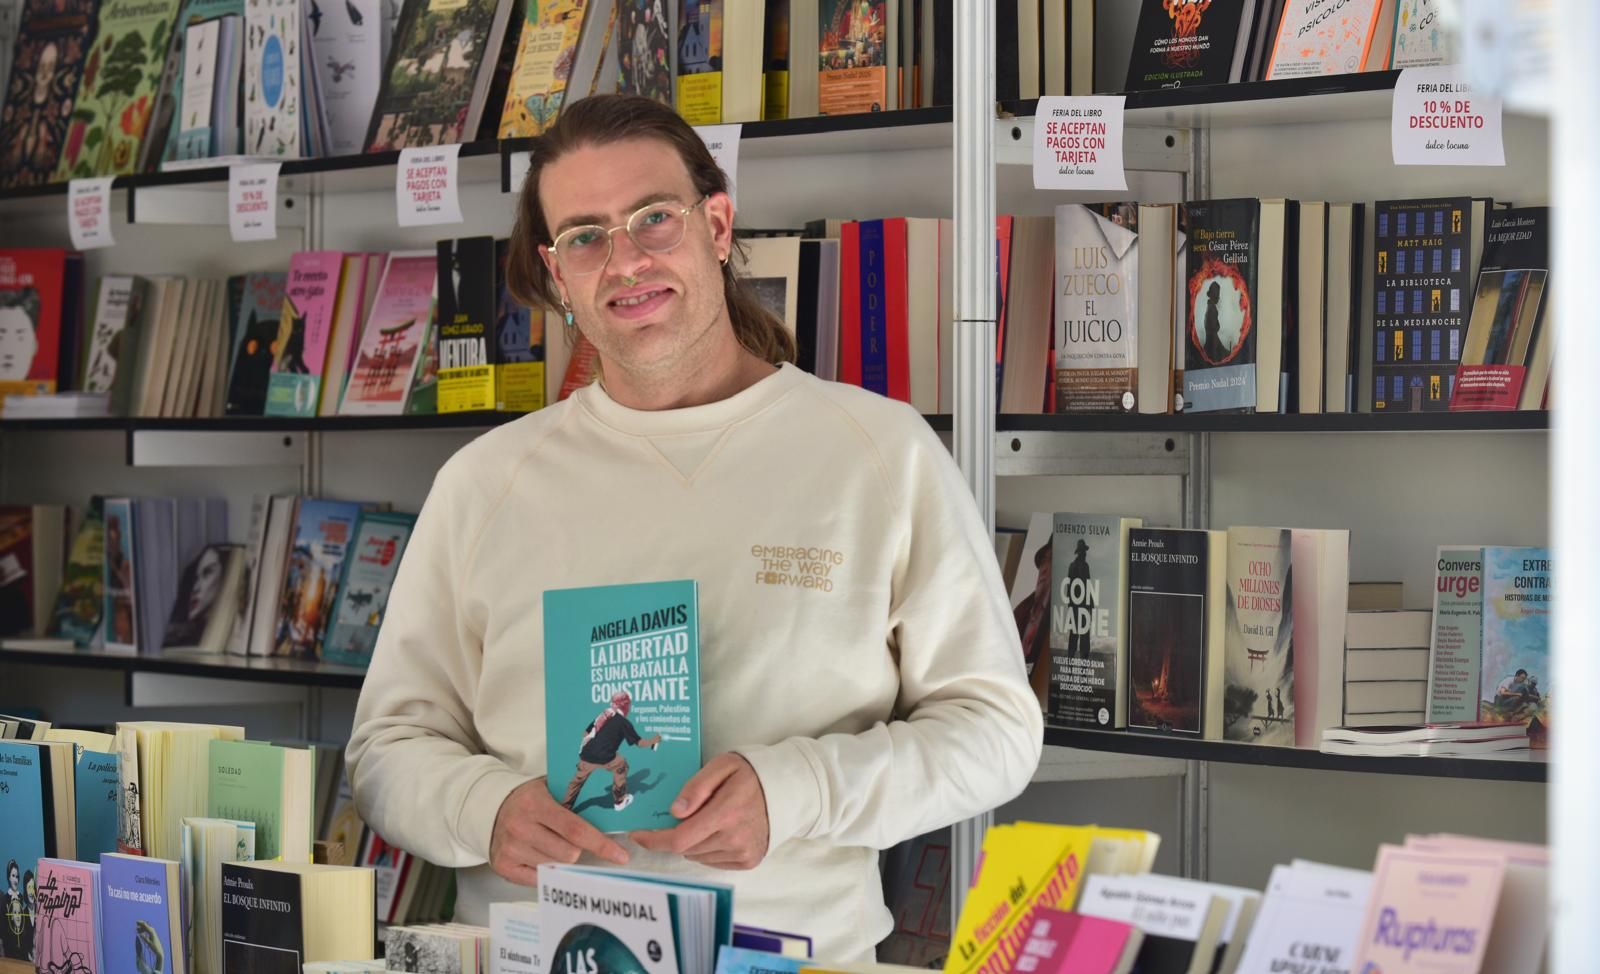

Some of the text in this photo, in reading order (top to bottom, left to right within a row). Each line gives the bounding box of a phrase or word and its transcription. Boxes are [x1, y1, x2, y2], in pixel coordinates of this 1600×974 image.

[1154, 38, 1169, 46] CÓMO
[1144, 71, 1204, 81] EDICIÓN ILUSTRADA
[1417, 84, 1454, 93] FERIA DEL
[1052, 109, 1103, 117] FERIA DEL LIBRO
[1423, 101, 1471, 113] 10 % DE
[1046, 122, 1106, 135] SE ACEPTAN
[1409, 115, 1484, 129] DESCUENTO
[1046, 137, 1105, 149] PAGOS CON
[1425, 139, 1470, 149] dulce locura
[1055, 151, 1097, 166] TARJETA
[1200, 229, 1215, 240] Bajo
[1488, 230, 1533, 245] LA MEJOR EDAD
[1208, 240, 1228, 251] César
[1230, 240, 1249, 250] Pérez
[1397, 239, 1443, 248] MATT HAIG
[1074, 247, 1108, 269] LUIS
[1223, 253, 1248, 264] Gellida
[1063, 273, 1121, 296] ZUECO
[1400, 278, 1452, 287] BIBLIOTECA
[1085, 300, 1097, 316] EL
[1376, 318, 1462, 327] DE LA MEDIANOCHE
[1063, 319, 1122, 348] JUICIO
[1189, 381, 1210, 391] Premio
[1211, 378, 1229, 389] Nadal
[1056, 523, 1110, 536] LORENZO SILVA
[1131, 538, 1165, 548] Annie Proulx
[1131, 552, 1199, 565] EL BOSQUE INFINITO
[1437, 558, 1481, 572] Convers
[1248, 560, 1272, 576] OCHO
[1060, 577, 1100, 606] CON
[1239, 578, 1281, 595] MILLONES
[1436, 575, 1480, 599] urge
[1237, 594, 1281, 613] DE DIOSES
[1504, 593, 1534, 602] HISTORIAS
[591, 604, 688, 642] ANGELA DAVIS
[1053, 605, 1109, 637] NADIE
[1243, 623, 1259, 635] David
[1265, 626, 1274, 637] Gil
[591, 632, 689, 667] LA LIBERTAD
[591, 656, 689, 682] ES UNA BATALLA
[1068, 657, 1091, 667] LORENZO
[1090, 660, 1105, 669] SILVA
[1060, 666, 1071, 674] PARA
[591, 677, 690, 703] CONSTANTE
[659, 704, 690, 713] Palestina
[87, 761, 96, 770] La
[218, 766, 241, 775] SOLEDAD
[224, 876, 253, 889] Annie Proulx
[113, 887, 124, 898] casi
[123, 891, 130, 900] no
[130, 892, 140, 902] me
[139, 891, 162, 904] acuerdo
[224, 893, 291, 912] EL BOSQUE INFINITO
[551, 888, 657, 922] ORDEN MUNDIAL
[1374, 906, 1479, 962] Rupturas
[501, 948, 507, 958] El
[566, 949, 598, 974] LAS
